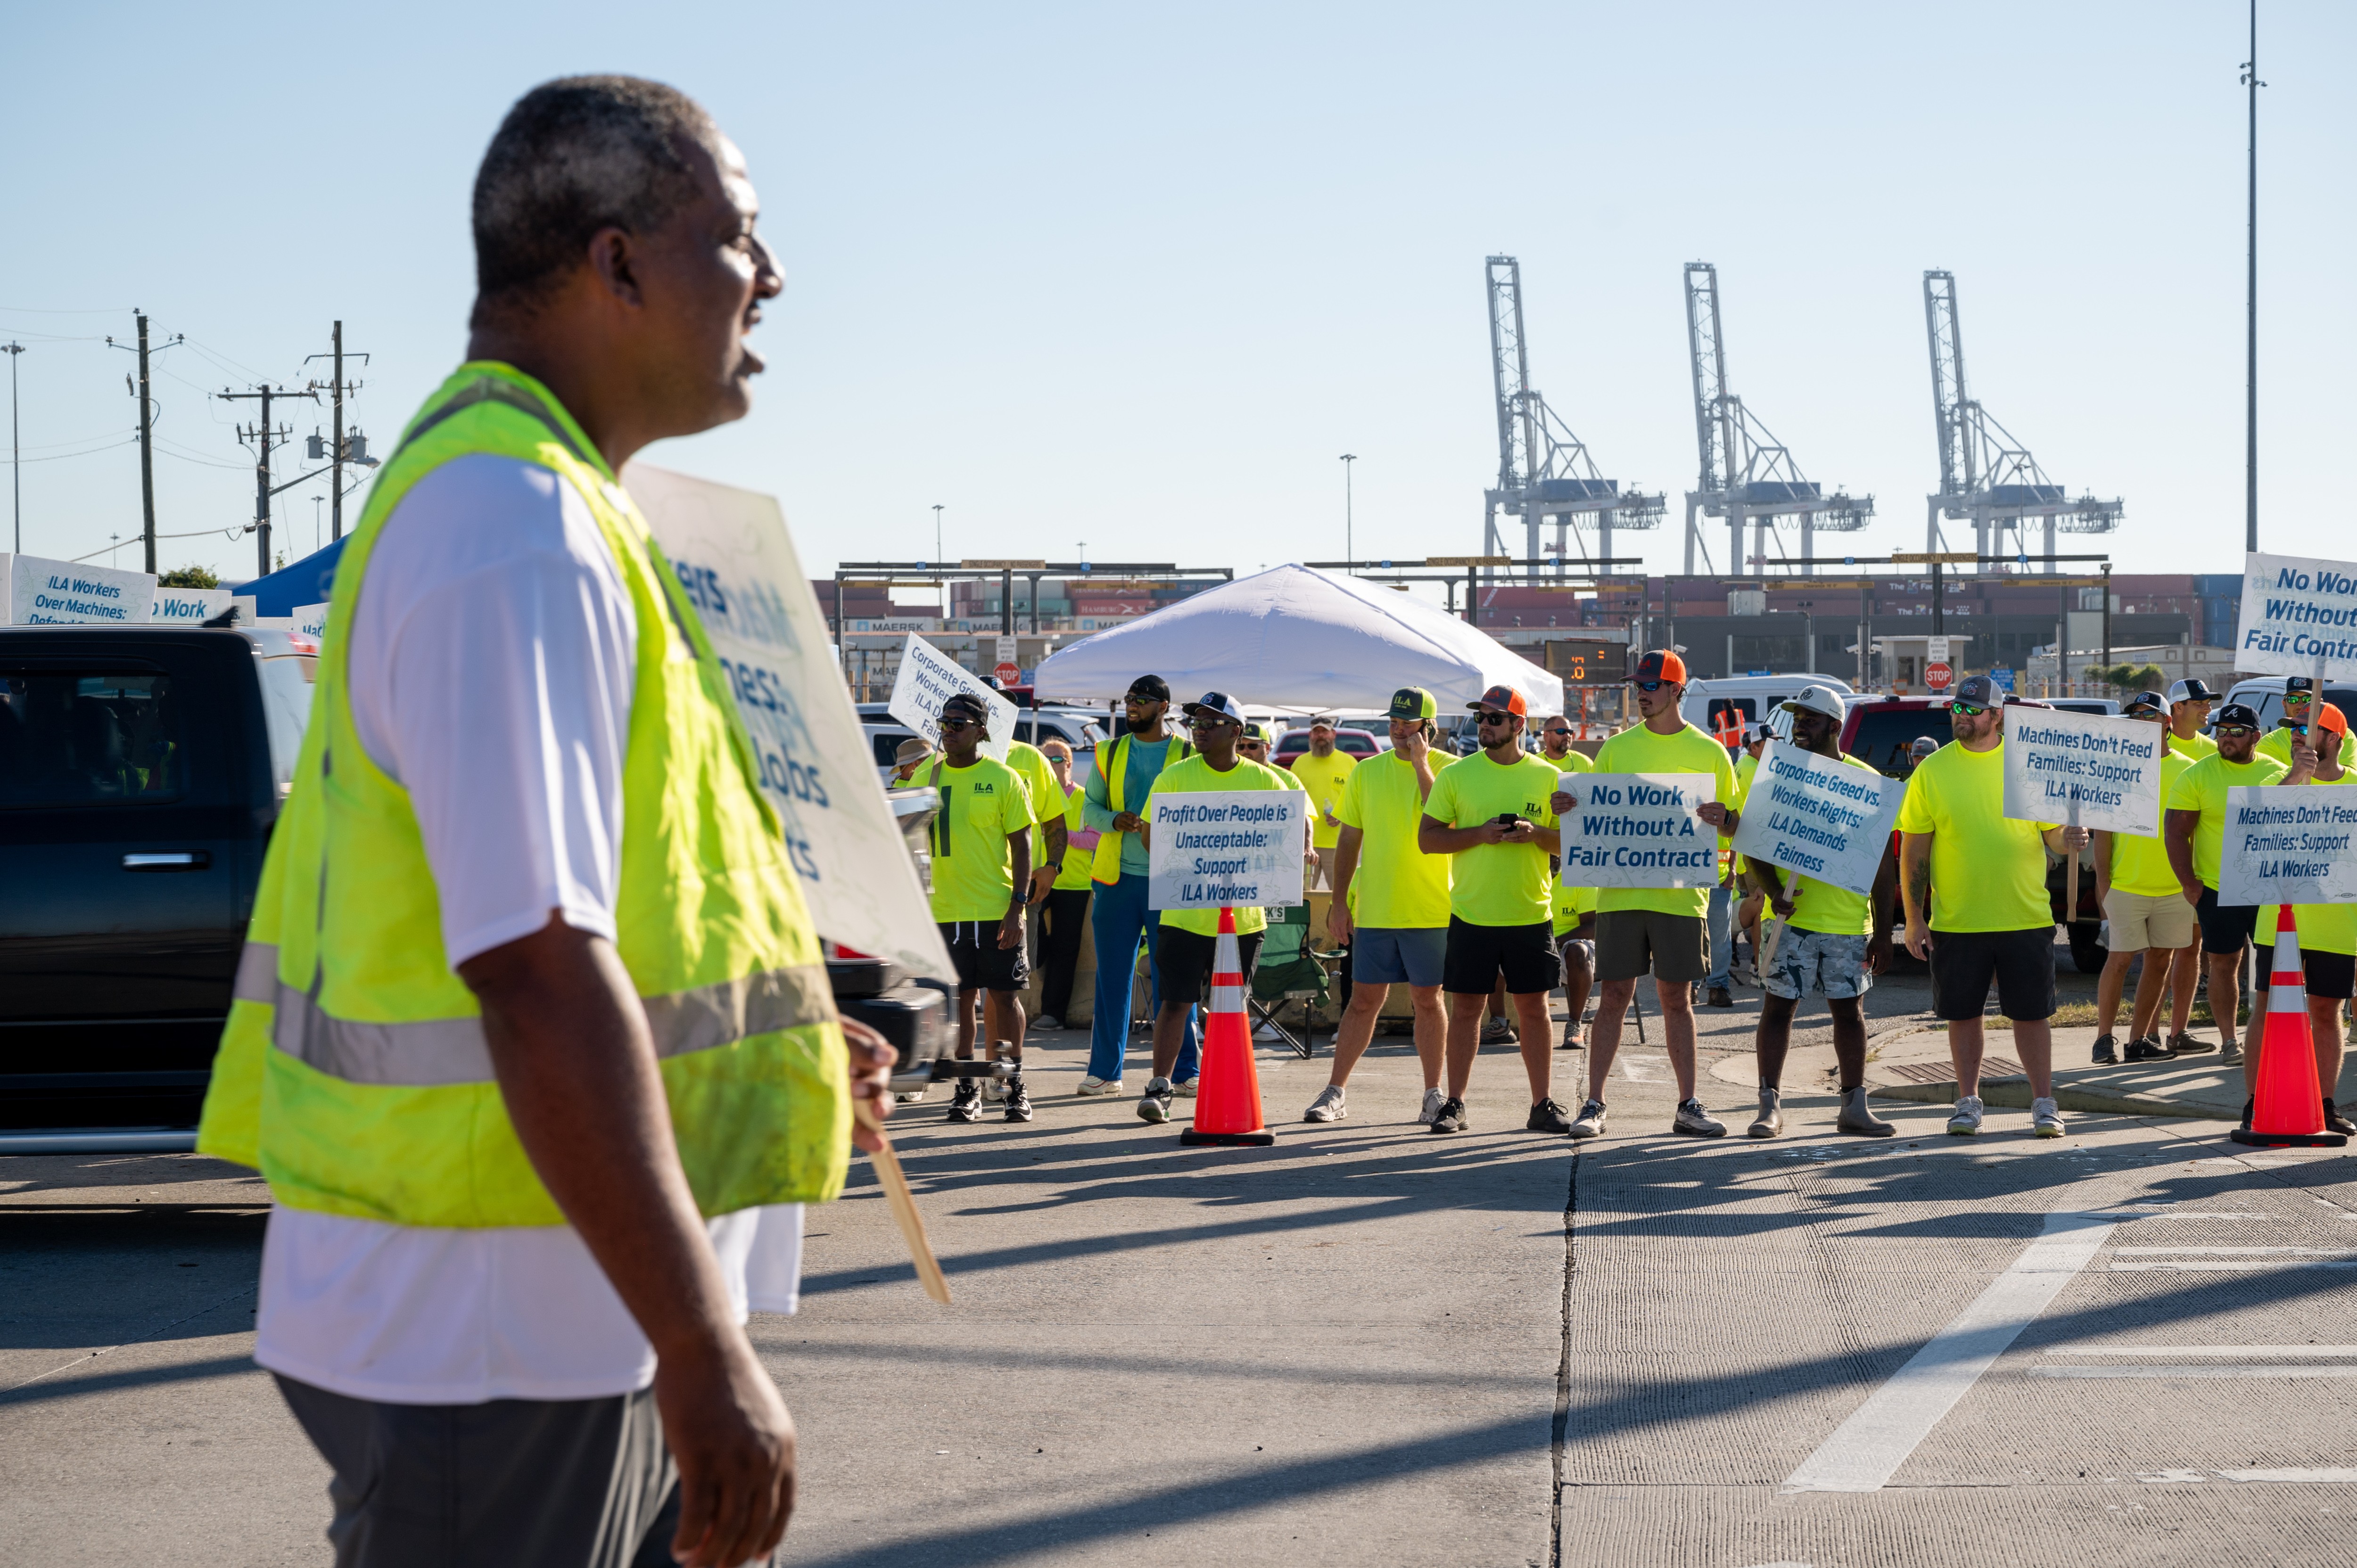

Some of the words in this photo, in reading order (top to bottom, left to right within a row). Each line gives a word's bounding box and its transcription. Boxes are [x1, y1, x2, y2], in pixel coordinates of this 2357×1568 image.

[1475, 557, 1482, 565] NO
[1483, 557, 1510, 565] PASSENGERS
[1892, 554, 1908, 563] SINGLE
[1910, 554, 1935, 562] OCCUPANCY
[1941, 553, 1947, 562] NO
[1948, 553, 1977, 562] PASSENGERS
[48, 575, 68, 591] ILA
[72, 579, 121, 598] Workers
[2277, 568, 2310, 590] No
[2316, 571, 2357, 595] Wor
[35, 594, 65, 611] Over
[65, 599, 127, 620] Machines:
[164, 599, 207, 618] Work
[2266, 599, 2357, 627] Without
[873, 623, 923, 631] MAERSK
[2244, 629, 2290, 652] Fair
[2293, 634, 2357, 659] Contr
[912, 646, 959, 688] Corporate
[996, 670, 1019, 681] STOP
[1927, 670, 1950, 681] STOP
[915, 693, 931, 714] ILA
[1394, 696, 1412, 706] ILA
[2018, 725, 2079, 748] Machines
[2082, 733, 2118, 754] Don't
[2120, 739, 2153, 759] Feed
[2027, 752, 2086, 775] Families:
[2088, 760, 2142, 783] Support
[974, 783, 993, 791] ILA
[1768, 755, 1828, 788] Corporate
[1827, 775, 1867, 801] Greed
[1865, 791, 1880, 806] vs.
[1591, 785, 1622, 805] No
[1628, 785, 1684, 805] Work
[2045, 780, 2066, 798] ILA
[2070, 782, 2122, 806] Workers
[1158, 805, 1197, 826] Profit
[1197, 805, 1228, 822] Over
[1229, 804, 1274, 824] People
[1276, 804, 1288, 821] is
[1525, 802, 1542, 813] ILA
[1771, 784, 1820, 813] Workers
[1818, 800, 1864, 829] Rights:
[2238, 806, 2295, 825] Machines
[2296, 805, 2330, 824] Don't
[1583, 816, 1674, 837] Without
[1678, 816, 1695, 837] A
[1768, 811, 1790, 833] ILA
[1789, 820, 1848, 852] Demands
[1176, 830, 1268, 851] Unacceptable:
[2244, 833, 2299, 851] Families:
[2300, 833, 2350, 854] Support
[1194, 857, 1247, 877] Support
[1567, 846, 1610, 866] Fair
[1615, 846, 1712, 867] Contract
[1772, 841, 1825, 872] Fairness
[2259, 860, 2278, 878] ILA
[2282, 859, 2330, 878] Workers
[1181, 884, 1202, 901] ILA
[1206, 883, 1257, 901] Workers
